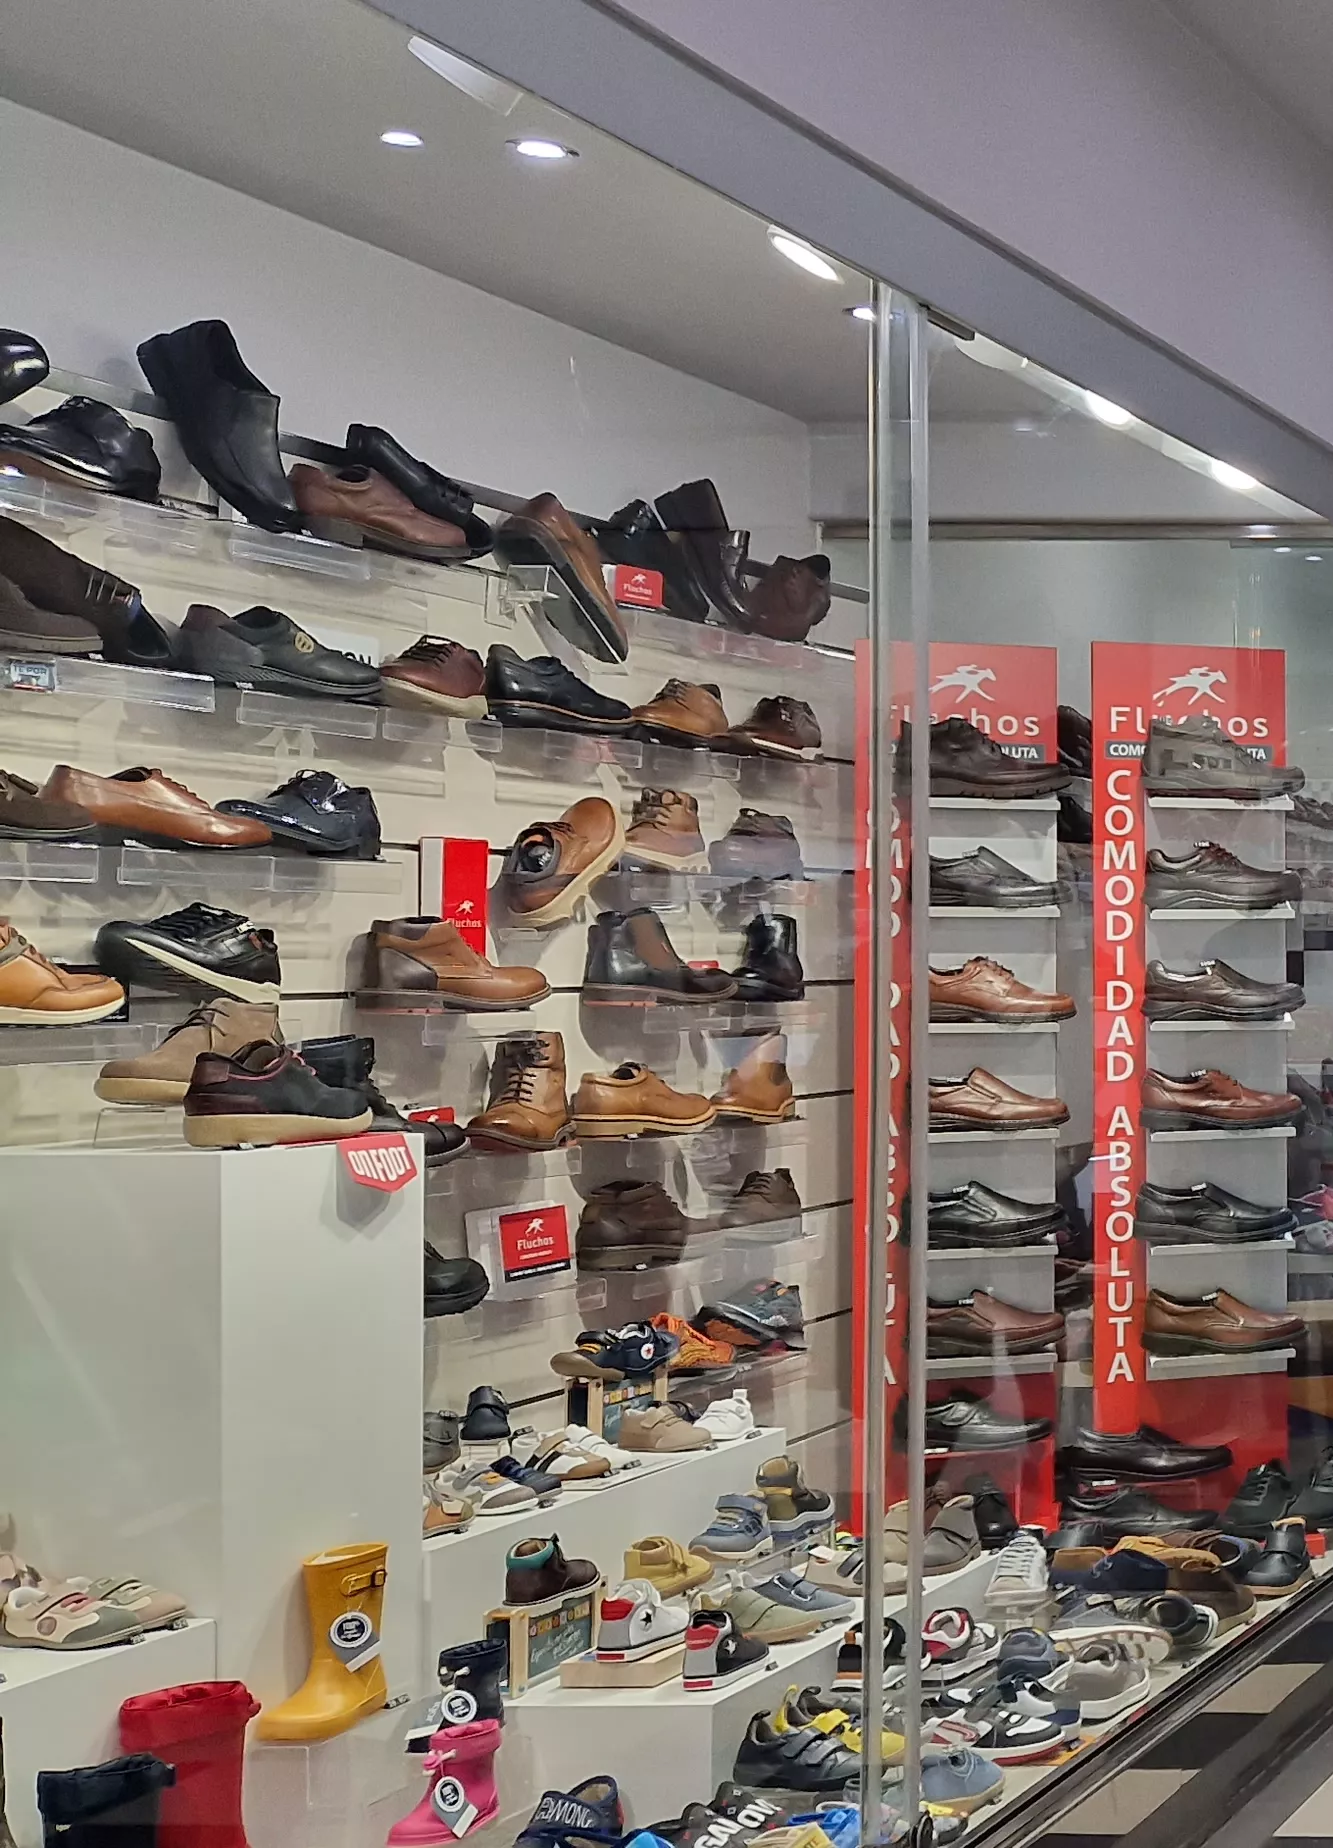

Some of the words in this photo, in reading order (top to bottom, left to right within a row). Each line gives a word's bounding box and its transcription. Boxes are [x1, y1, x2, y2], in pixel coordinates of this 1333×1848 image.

[1102, 768, 1137, 1083] COMODIDAD
[516, 1236, 555, 1252] Fluchos
[1105, 1105, 1136, 1383] ABSOLUTA
